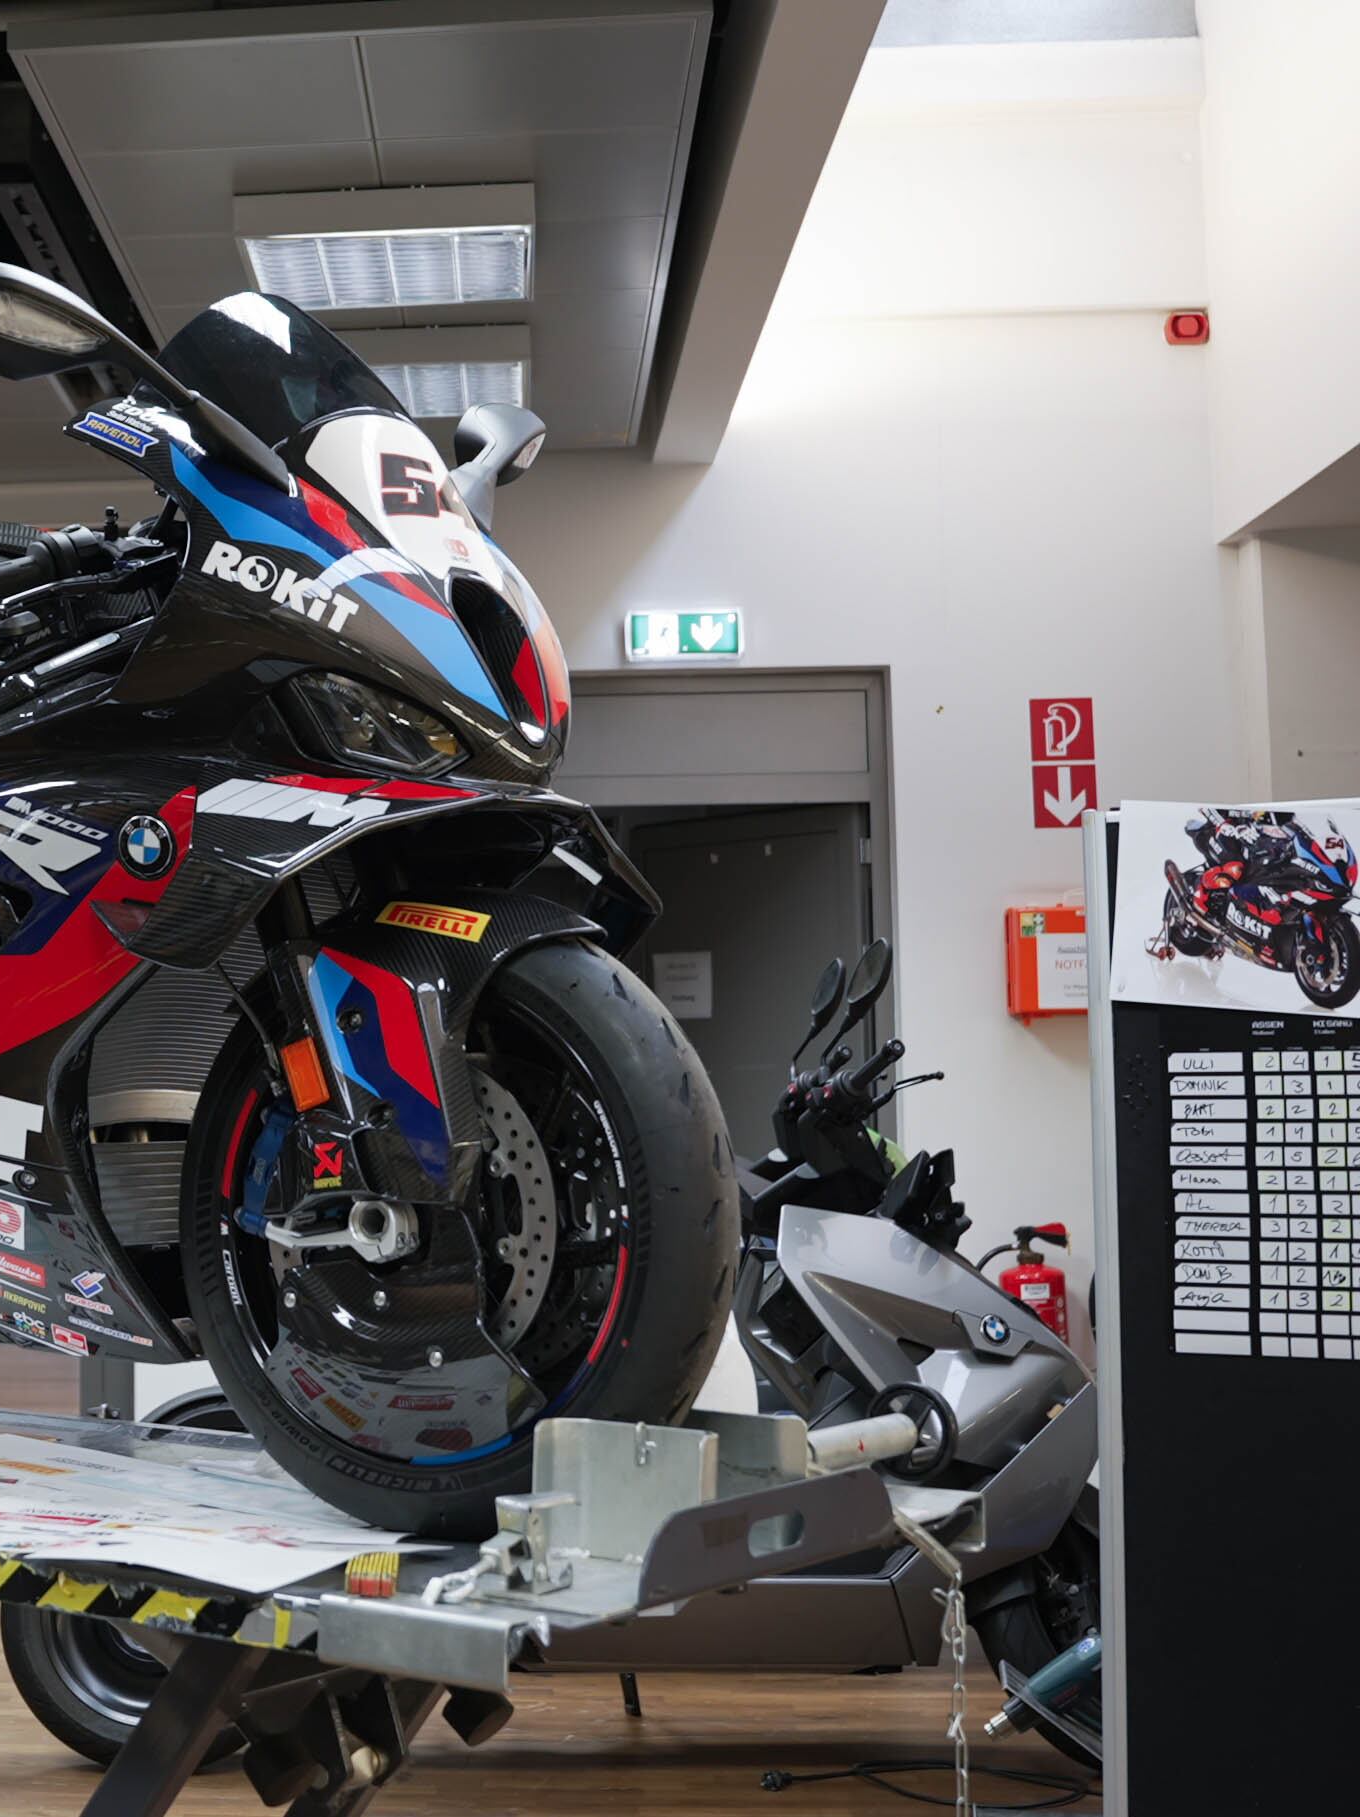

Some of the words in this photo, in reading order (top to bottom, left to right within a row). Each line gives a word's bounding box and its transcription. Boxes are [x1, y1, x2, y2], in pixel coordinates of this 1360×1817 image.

[86, 418, 143, 449] RAVENOL
[390, 904, 479, 937] PIRELLI
[1264, 1055, 1275, 1068] 2
[1292, 1057, 1305, 1069] 4
[1323, 1056, 1330, 1068] 1
[1265, 1079, 1273, 1091] 1
[1292, 1080, 1304, 1093] 3
[1327, 1080, 1332, 1090] 1
[1265, 1105, 1275, 1116] 2
[1291, 1105, 1307, 1114] 2
[1329, 1103, 1338, 1115] 2
[1266, 1126, 1275, 1135] 1
[1264, 1151, 1274, 1161] 1
[1290, 1151, 1303, 1161] 5
[1325, 1149, 1338, 1164] 2
[1267, 1175, 1278, 1185] 2
[1295, 1175, 1308, 1185] 2
[1327, 1176, 1335, 1188] 1
[1269, 1196, 1276, 1212] 1
[1333, 1200, 1344, 1214] 2
[1270, 1220, 1281, 1233] 3
[1299, 1221, 1312, 1234] 2
[1331, 1220, 1343, 1233] 2
[1270, 1245, 1280, 1259] 1
[1292, 1247, 1307, 1261] 2
[1329, 1245, 1339, 1259] 1
[1296, 1268, 1307, 1283] 2
[1269, 1292, 1280, 1304] 1
[1295, 1292, 1310, 1307] 3
[1330, 1294, 1344, 1307] 2
